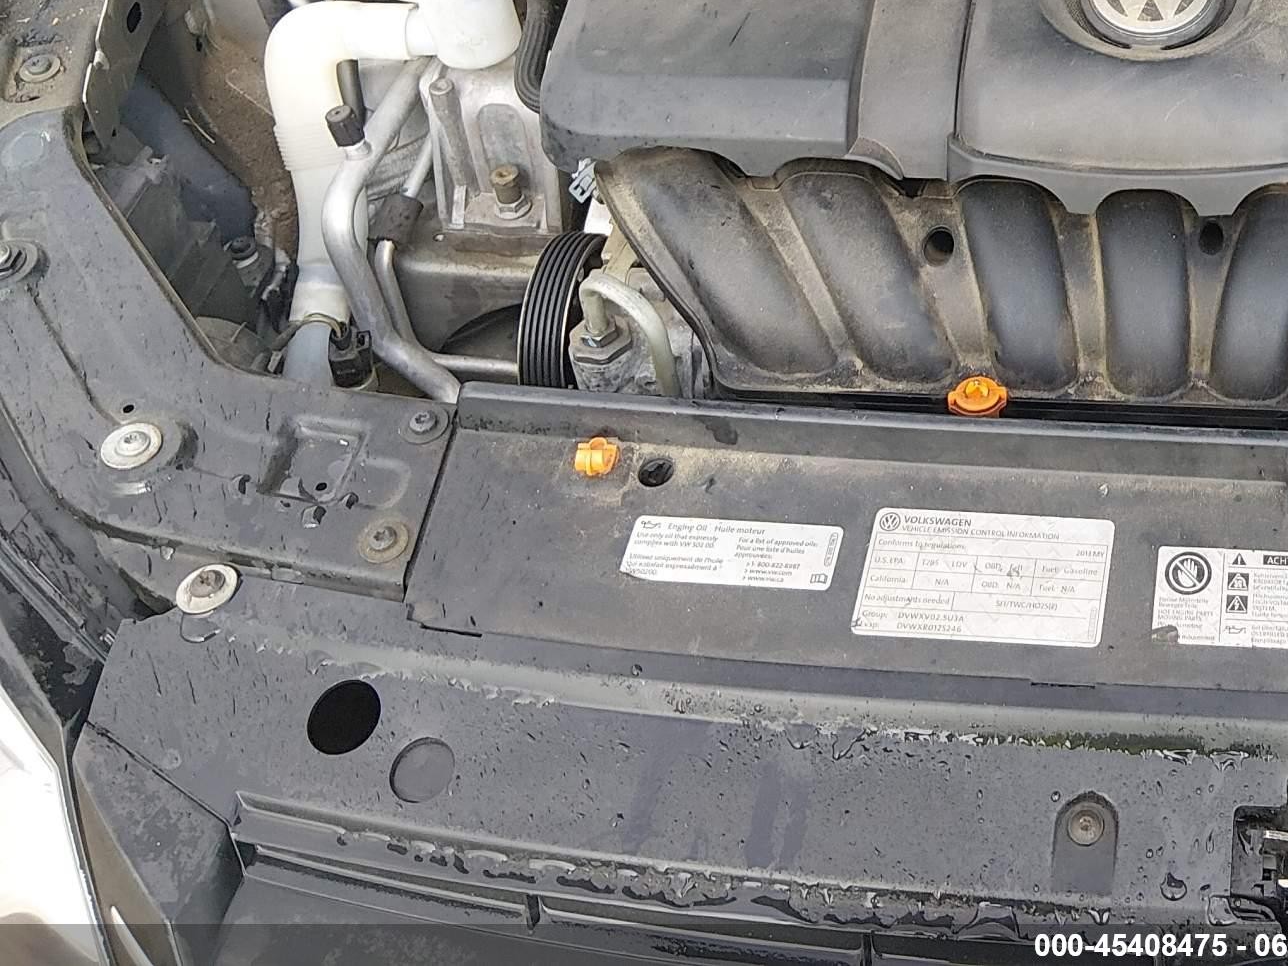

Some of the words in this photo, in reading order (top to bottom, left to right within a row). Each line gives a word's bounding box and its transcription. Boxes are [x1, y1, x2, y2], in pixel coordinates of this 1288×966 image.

[904, 515, 972, 526] VOLKSWAGEN
[668, 523, 694, 532] Engine
[715, 524, 734, 534] Huile
[737, 527, 765, 535] moteur
[902, 525, 931, 533] VEHICLE
[933, 527, 968, 535] EMISSION
[970, 530, 1004, 538] CONTROL
[1007, 532, 1059, 540] INFORMATION
[878, 539, 913, 547] Conforms
[935, 578, 949, 586] N/A
[1006, 582, 1021, 590] N/A
